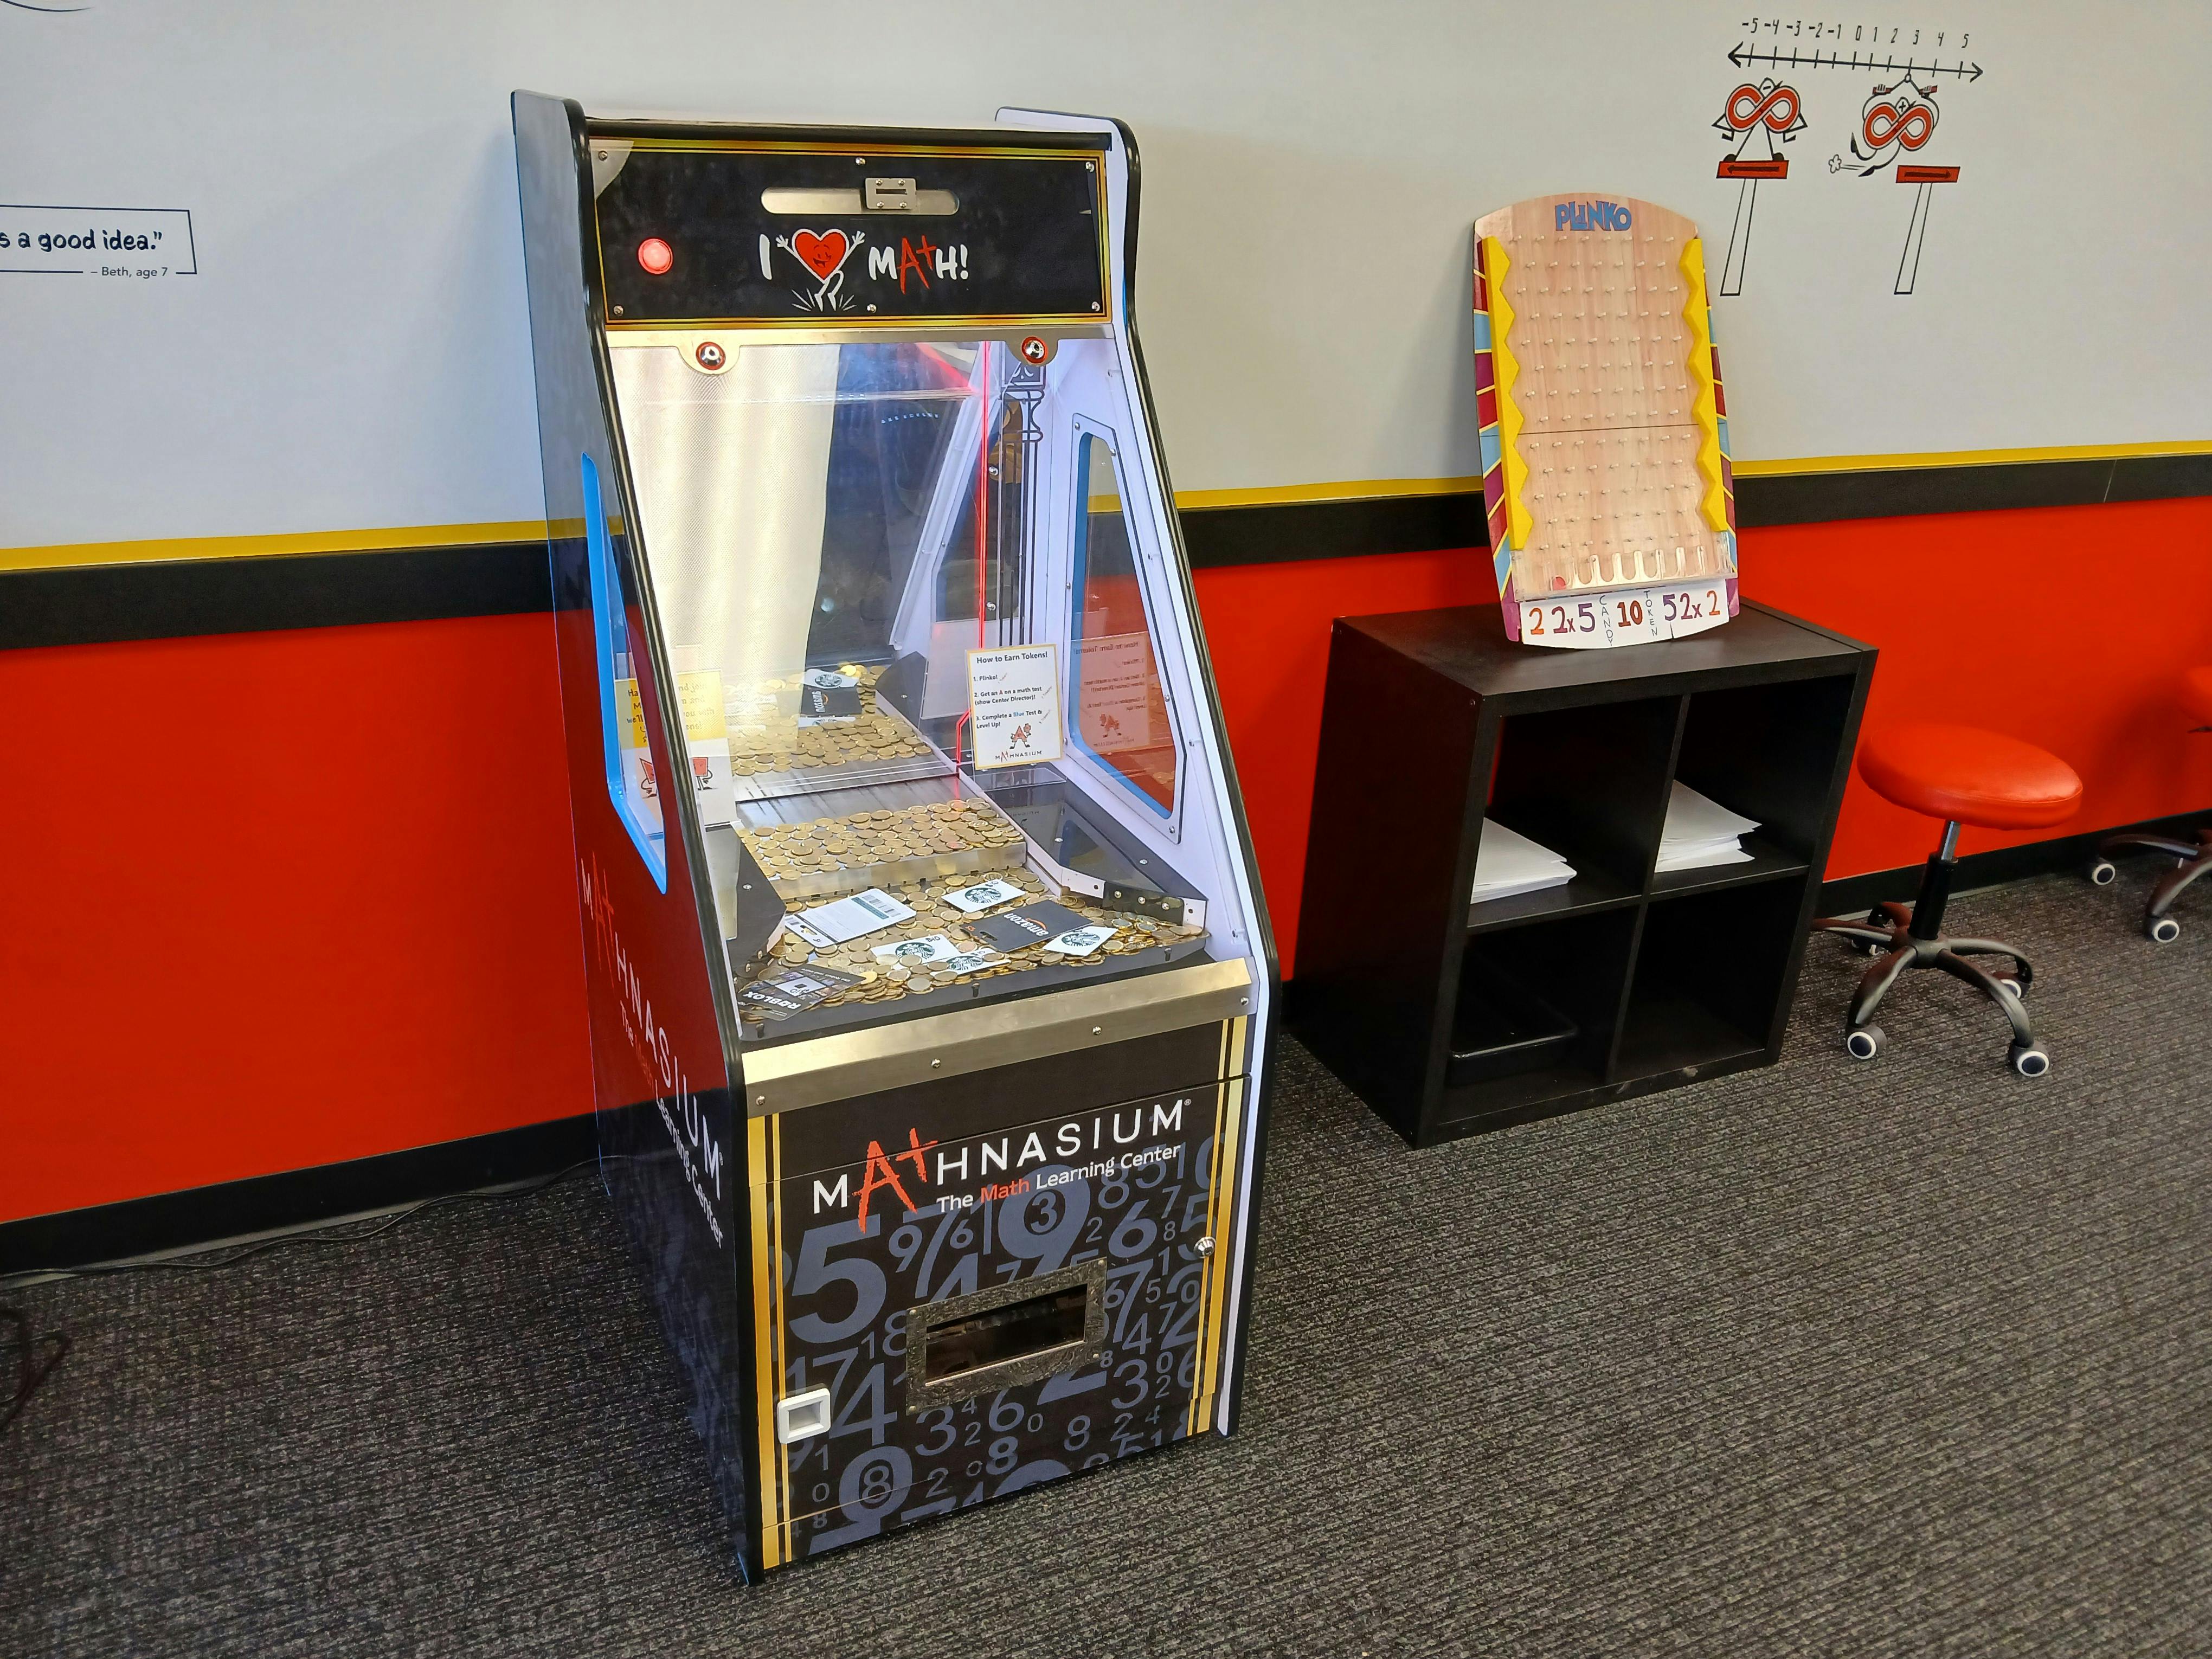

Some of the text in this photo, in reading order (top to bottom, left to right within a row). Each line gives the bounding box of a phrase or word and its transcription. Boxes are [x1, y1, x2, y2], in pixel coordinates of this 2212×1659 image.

[1741, 17, 1969, 48] -5 -4 -3 -2 -1 0 1 2 3 4 5
[1554, 201, 1632, 232] PLINKO
[18, 233, 31, 249] a
[38, 228, 97, 253] good
[758, 234, 773, 280] I
[101, 266, 132, 279] Beth,
[136, 268, 158, 279] age
[161, 267, 168, 276] 7
[1529, 607, 1544, 635] 2
[1578, 602, 1596, 633] 5
[1617, 600, 1644, 628] 10
[1662, 594, 1677, 621] 5
[1706, 590, 1721, 616] 2
[1599, 595, 1614, 647] CANDY
[1643, 590, 1658, 636] TOKEN
[1021, 651, 1048, 660] Tokens!
[982, 712, 1007, 721] Complete
[1003, 913, 1049, 936] amazon
[742, 991, 802, 1009] ROBLOX
[655, 1079, 691, 1182] Learning
[691, 1164, 724, 1249] Center
[936, 1144, 1182, 1213] The Math Learning Center
[1031, 1191, 1057, 1233] 3
[1162, 1185, 1181, 1219] 7
[950, 1218, 974, 1250] 6
[1085, 1217, 1103, 1243] 2
[1108, 1199, 1158, 1258] 6
[1163, 1220, 1176, 1242] 8
[888, 1225, 923, 1273] 9
[1158, 1246, 1170, 1276] 1
[789, 1213, 887, 1344] 5
[1145, 1278, 1161, 1304] 5
[1122, 1313, 1152, 1355] 4
[1159, 1301, 1178, 1334] 7
[860, 1331, 874, 1360] 1
[1111, 1358, 1149, 1410] 3
[1155, 1374, 1172, 1399] 2
[828, 1362, 898, 1446] 4
[915, 1405, 957, 1457] 3
[964, 1421, 981, 1446] 2
[986, 1436, 1019, 1476] 8
